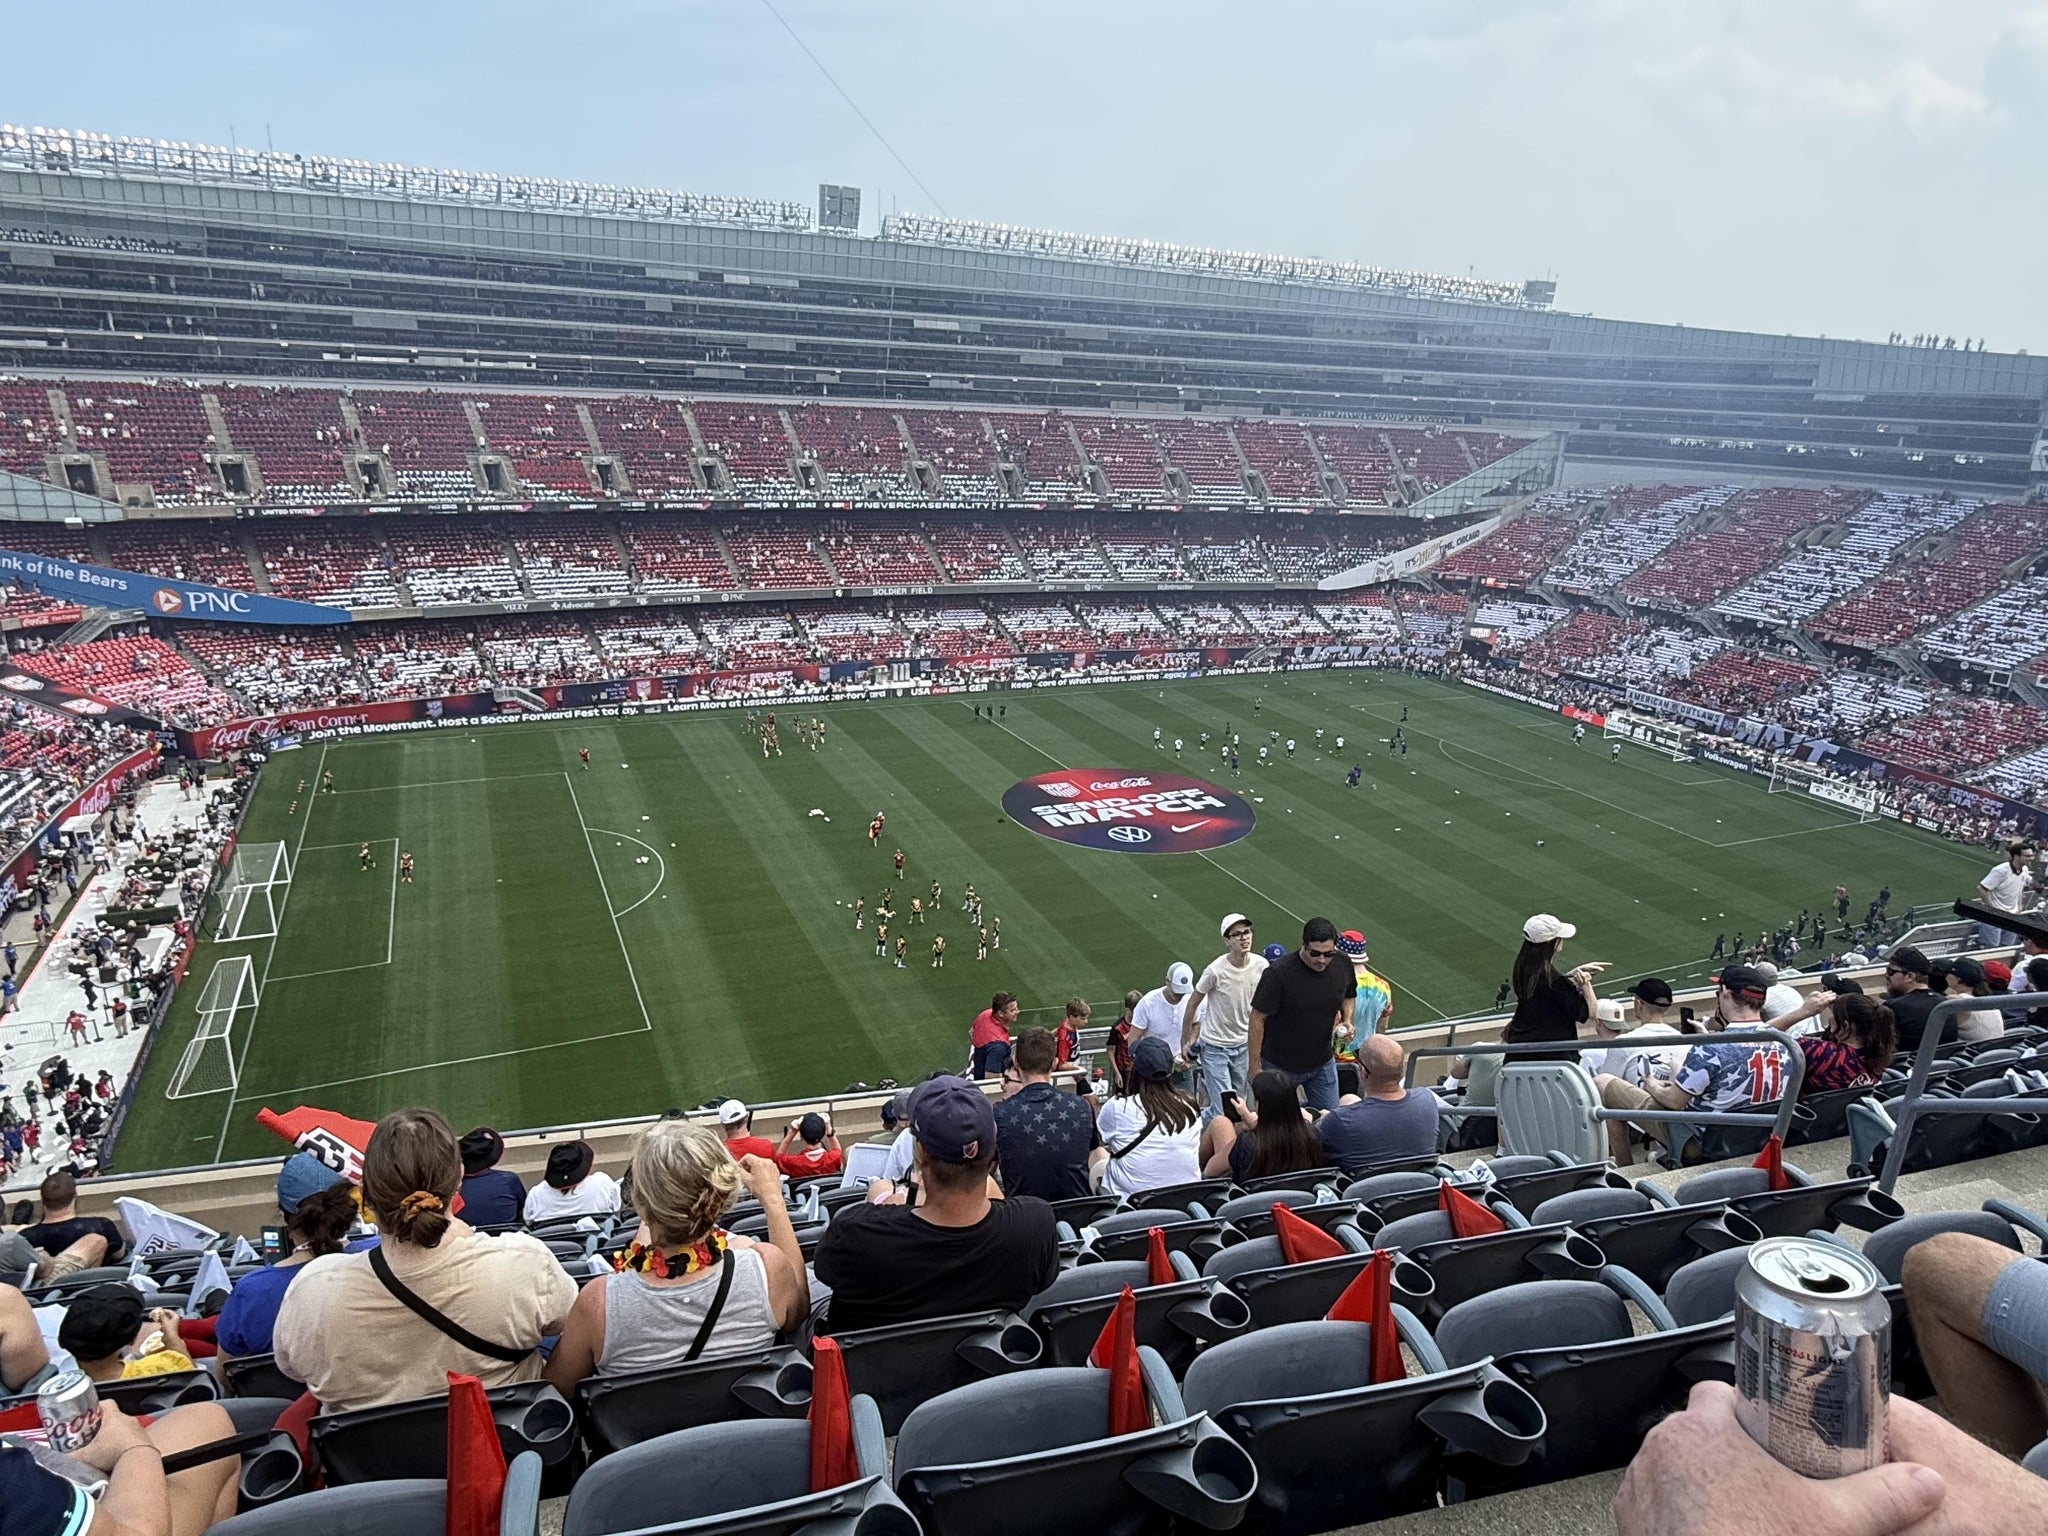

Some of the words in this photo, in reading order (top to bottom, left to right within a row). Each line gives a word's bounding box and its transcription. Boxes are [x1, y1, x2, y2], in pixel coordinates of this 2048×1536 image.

[262, 508, 288, 516] UNITED
[368, 506, 401, 514] GERMANY
[854, 502, 990, 510] #NEVERCHASEREALITY
[26, 557, 43, 575] of
[47, 562, 76, 581] the
[79, 570, 128, 592] Bears
[872, 587, 908, 596] SOLDIER
[911, 586, 933, 595] FIELD
[186, 591, 251, 613] PNC
[562, 602, 596, 610] Advocate
[750, 670, 793, 679] SEND-OFF
[1206, 668, 1222, 676] Join
[1222, 666, 1236, 675] the
[1010, 680, 1033, 690] Keep
[1068, 677, 1092, 686] What
[1092, 676, 1127, 685] Matters.
[1128, 674, 1144, 682] Join
[1145, 672, 1159, 680] the
[910, 688, 931, 696] USA
[968, 684, 988, 693] GER
[668, 701, 699, 712] Learn
[700, 700, 727, 710] More
[728, 698, 741, 709] at
[1628, 691, 1670, 711] AMERICAN
[1680, 705, 1721, 724] OUTLAWS
[338, 724, 362, 736] the
[363, 718, 437, 734] Movement.
[438, 716, 468, 728] Host
[480, 714, 519, 726] Soccer
[522, 711, 573, 723] Forward
[574, 708, 600, 719] Fest
[1704, 750, 1749, 771] Volkswagen
[1090, 777, 1152, 792] Coca-Cola
[1030, 788, 1205, 818] SEND-OFF
[1950, 787, 2004, 809] SEND-OFF
[1041, 795, 1226, 828] MATCH
[1880, 806, 1900, 818] TRULY
[1916, 816, 1939, 829] TRULY
[1747, 1050, 1780, 1103] 11
